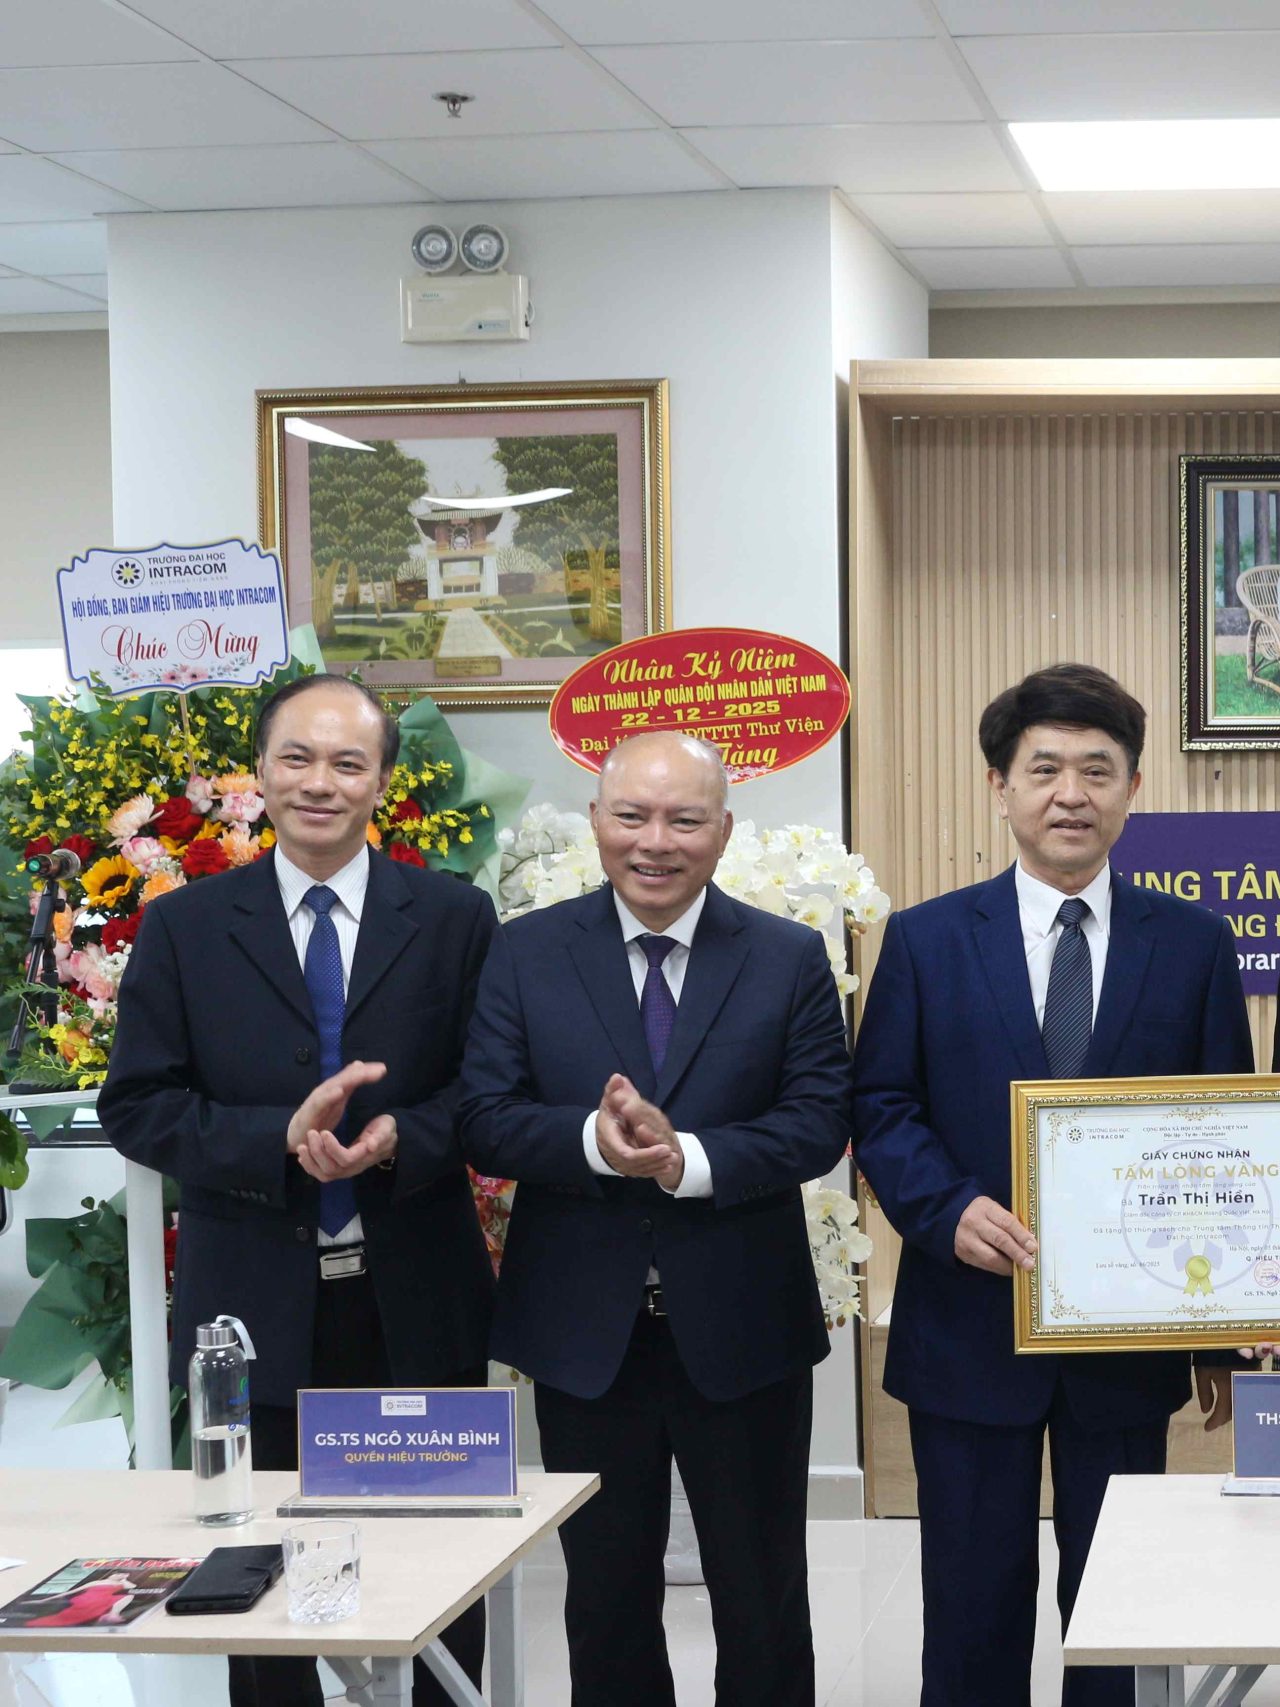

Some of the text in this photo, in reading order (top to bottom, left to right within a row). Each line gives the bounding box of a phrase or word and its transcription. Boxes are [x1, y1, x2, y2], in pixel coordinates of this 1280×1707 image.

[149, 562, 227, 579] INTRACOM
[72, 597, 86, 621] HỘI
[112, 598, 128, 614] BAN
[152, 591, 171, 615] HIỆU
[204, 590, 218, 612] ĐẠI
[219, 589, 235, 610] HỌC
[236, 586, 277, 606] INTRACOM
[101, 618, 260, 668] Chúc Mừng
[603, 647, 798, 684] Nhân Kỷ Niệm
[571, 674, 827, 714] NGÀY THÀNH LẬP QUÂN ĐỘI NHÂN DÂN VIỆT NAM
[621, 712, 650, 727] 22
[673, 707, 701, 722] 12
[724, 700, 780, 717] 2025
[580, 736, 610, 755] Đại
[746, 722, 780, 737] Thư
[785, 716, 824, 735] Viện
[1142, 1148, 1250, 1160] GIẤY CHỨNG NHẬN
[1112, 1161, 1279, 1180] TẤM LÒNG VÀNG
[1138, 1191, 1177, 1206] Trần
[1182, 1191, 1209, 1207] Thị
[1215, 1189, 1255, 1204] Hiền
[314, 1429, 500, 1446] GS.TS NGÔ XUÂN BÌNH
[387, 1451, 416, 1464] HIỆU
[418, 1450, 468, 1462] TRƯỞNG
